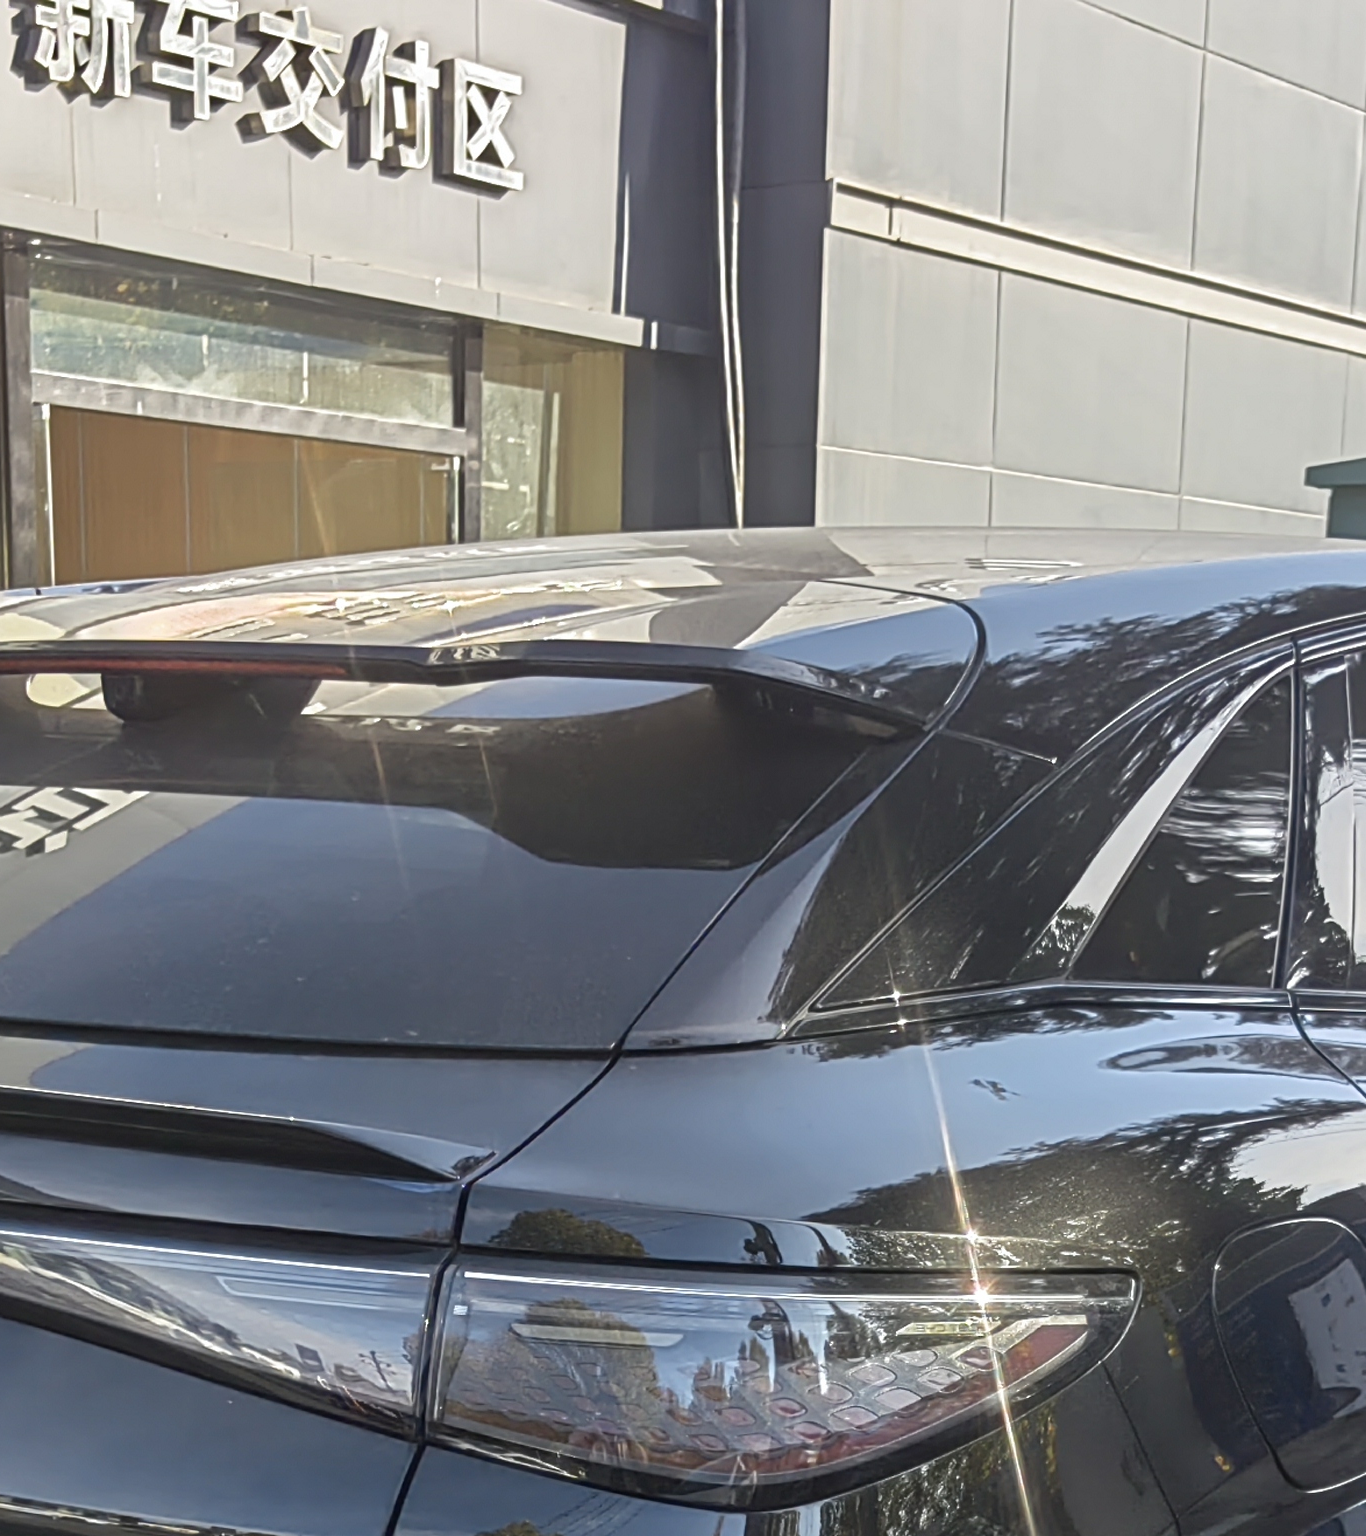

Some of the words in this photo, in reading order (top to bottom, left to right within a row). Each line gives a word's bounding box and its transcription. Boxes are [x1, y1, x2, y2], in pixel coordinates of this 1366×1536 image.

[18, 0, 525, 192] 新车交付区
